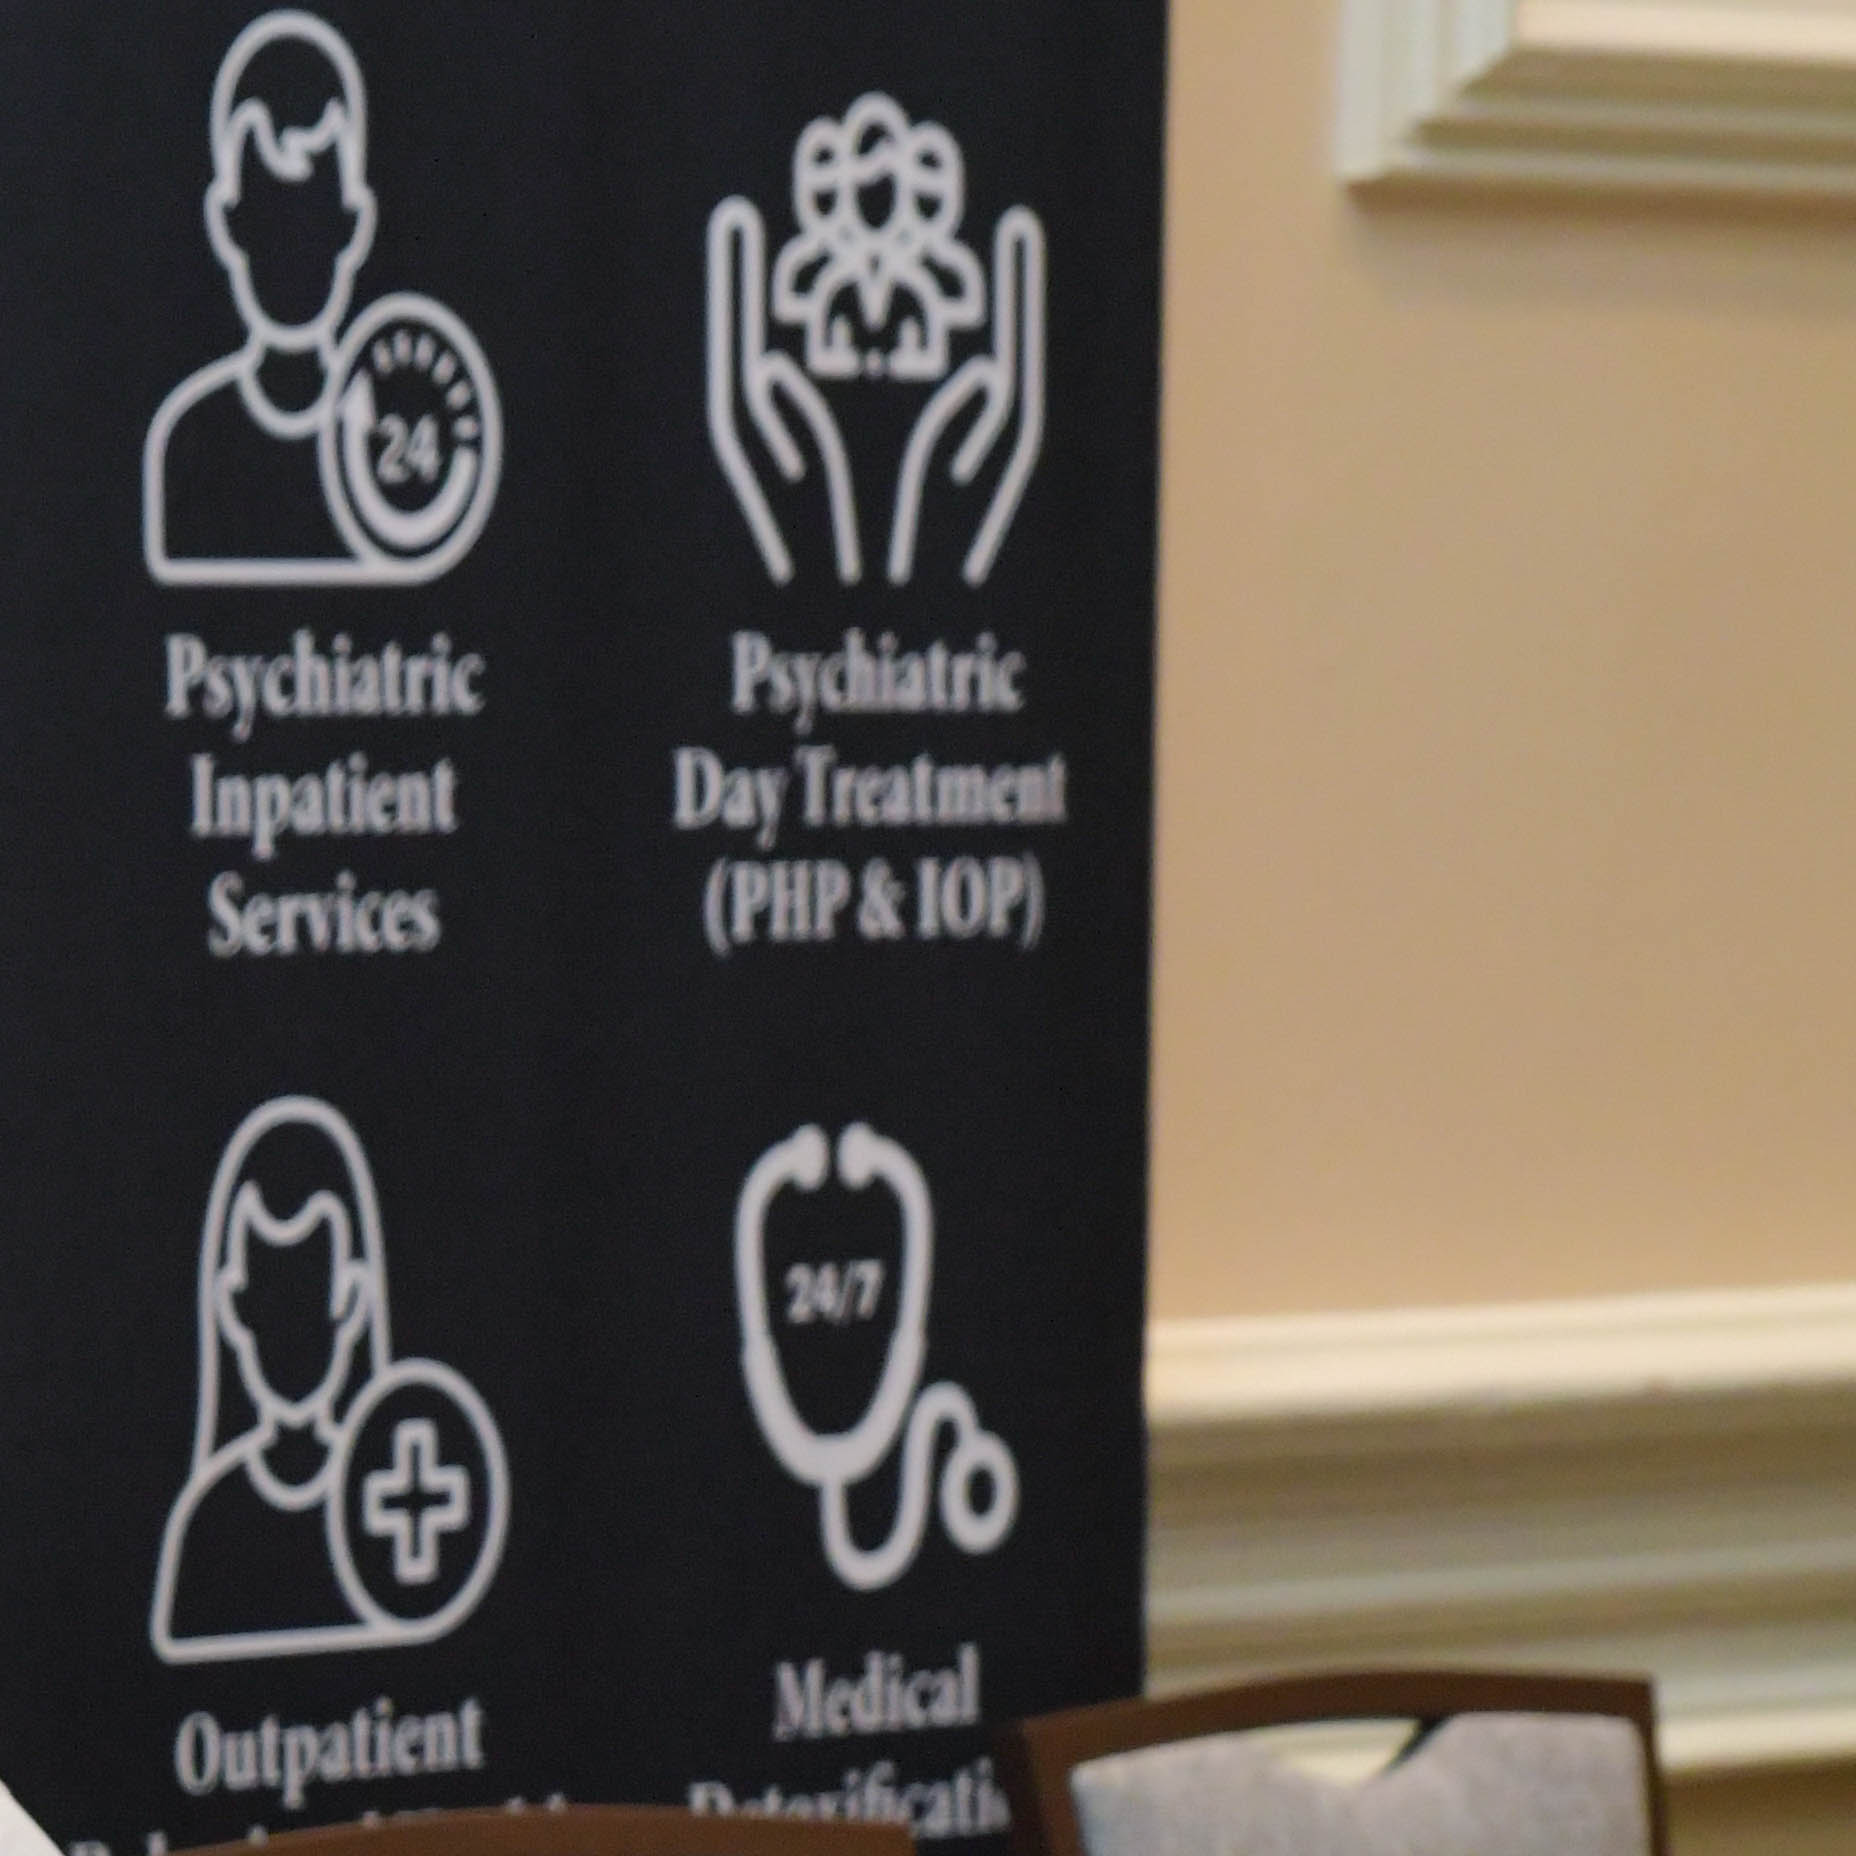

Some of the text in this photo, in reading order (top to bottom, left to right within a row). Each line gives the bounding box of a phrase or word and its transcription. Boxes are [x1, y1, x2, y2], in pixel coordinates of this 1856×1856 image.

[377, 415, 442, 485] 24
[164, 629, 485, 741] Psychiatric
[730, 628, 1026, 733] Psychiatric
[190, 753, 458, 858] Inpatient
[672, 742, 1069, 848] Day Treatment
[208, 870, 442, 960] Services
[703, 851, 1047, 957] (PHP & IOP)
[785, 1260, 885, 1328] 24/7
[771, 1643, 981, 1741] Medical
[174, 1695, 485, 1809] Outpatient
